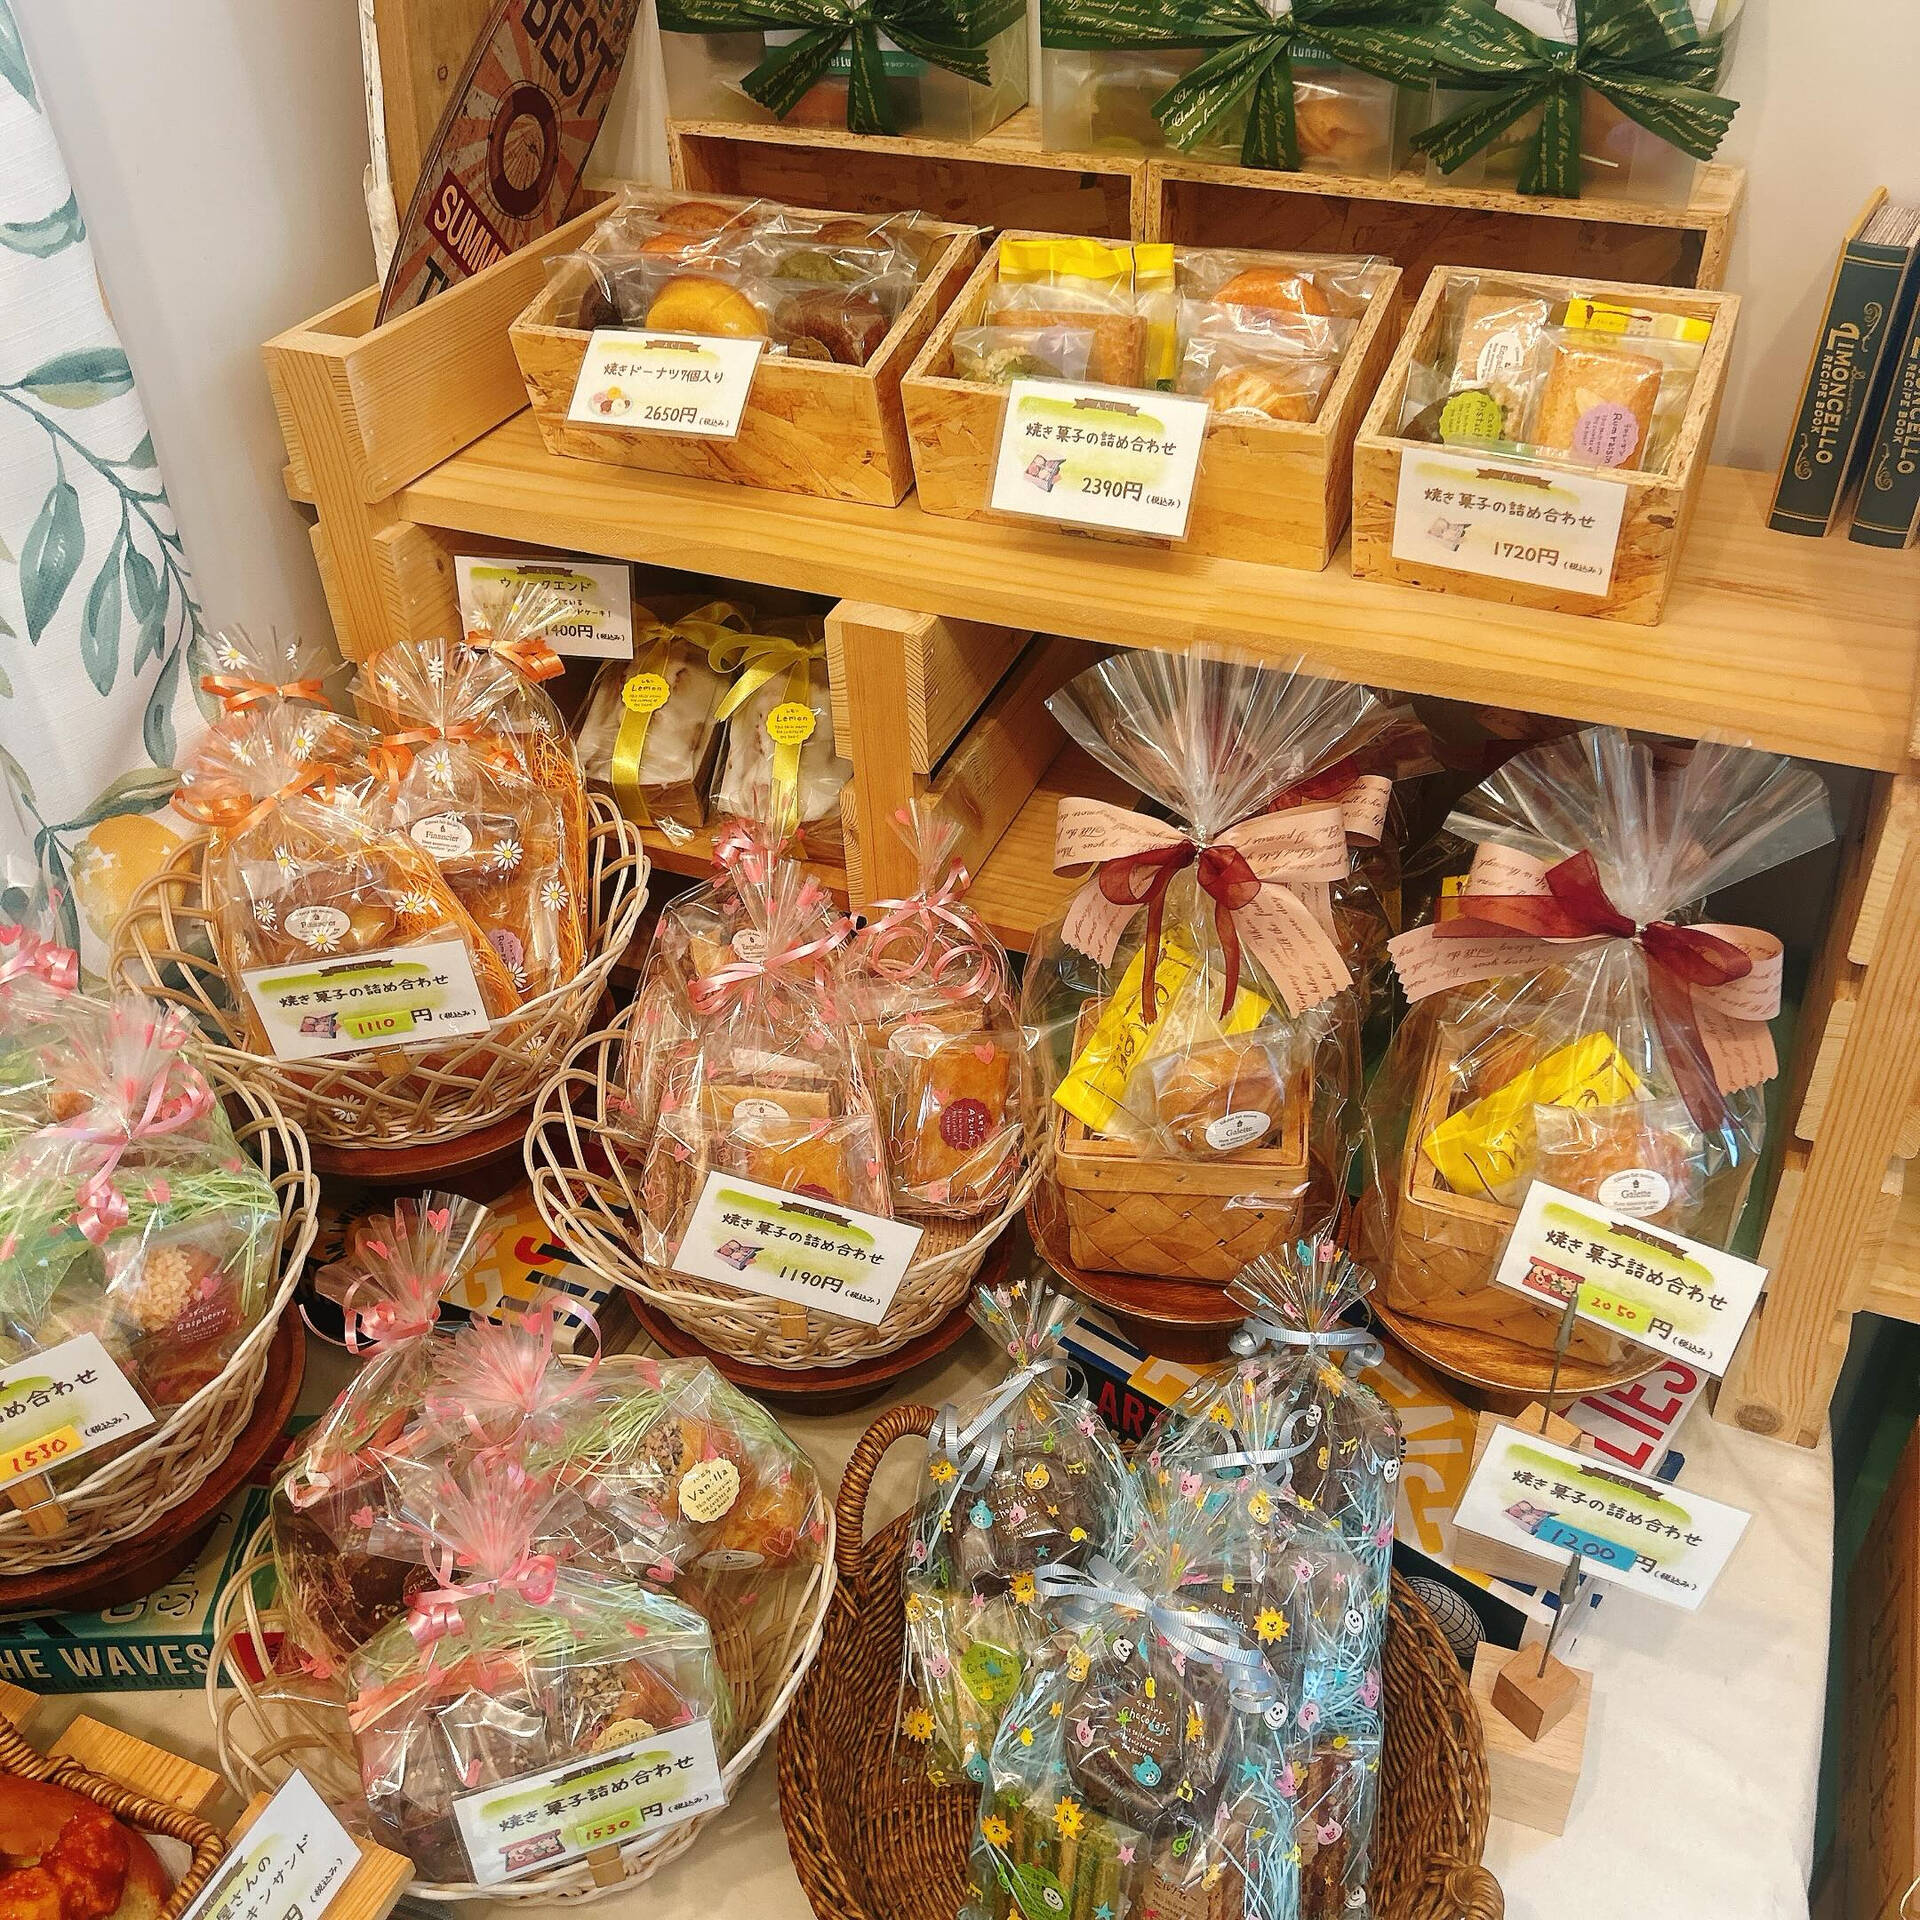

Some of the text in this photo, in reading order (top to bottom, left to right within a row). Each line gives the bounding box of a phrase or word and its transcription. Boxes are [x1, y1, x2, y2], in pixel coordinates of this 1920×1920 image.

[603, 362, 724, 384] 焼きドーナツ7個入り
[1811, 353, 1834, 433] RECIPE BOOK
[1816, 322, 1860, 464] LIMONCELLO
[1893, 363, 1919, 443] RECIPE BOOK
[644, 405, 697, 424] 2650円
[1025, 421, 1177, 456] 焼き菓子の詰め合わせ
[1081, 477, 1143, 502] 2390円
[1424, 487, 1596, 529] 焼き菓子の詰め合わせ
[1493, 541, 1560, 566] 1720円
[544, 624, 593, 640] 1400円
[631, 684, 662, 693] Lemon
[775, 714, 808, 723] Lemon
[278, 974, 448, 1008] 焼き菓子の詰め合わせ
[358, 1018, 395, 1035] 1110
[411, 1008, 433, 1024] 円
[721, 1212, 885, 1266] 焼き菓子の詰め合わせ
[778, 1265, 845, 1294] 1190円
[1545, 1229, 1728, 1313] 焼き菓子詰め合わせ
[1590, 1296, 1637, 1321] 2050
[1648, 1316, 1674, 1340] 円
[0, 1369, 98, 1424] め合わせ
[12, 1438, 67, 1473] 1530
[687, 1469, 728, 1502] Vanilla
[993, 1494, 1038, 1521] Choclate
[1511, 1469, 1703, 1547] 焼き菓子の詰め合わせ
[1549, 1527, 1616, 1562] 1200
[1635, 1554, 1657, 1574] 円
[58, 1644, 211, 1678] WAVES
[1121, 1706, 1172, 1736] Chocolate
[499, 1755, 695, 1833] 焼き菓子詰め合わせ
[585, 1819, 631, 1842] 1530
[640, 1801, 664, 1822] 円
